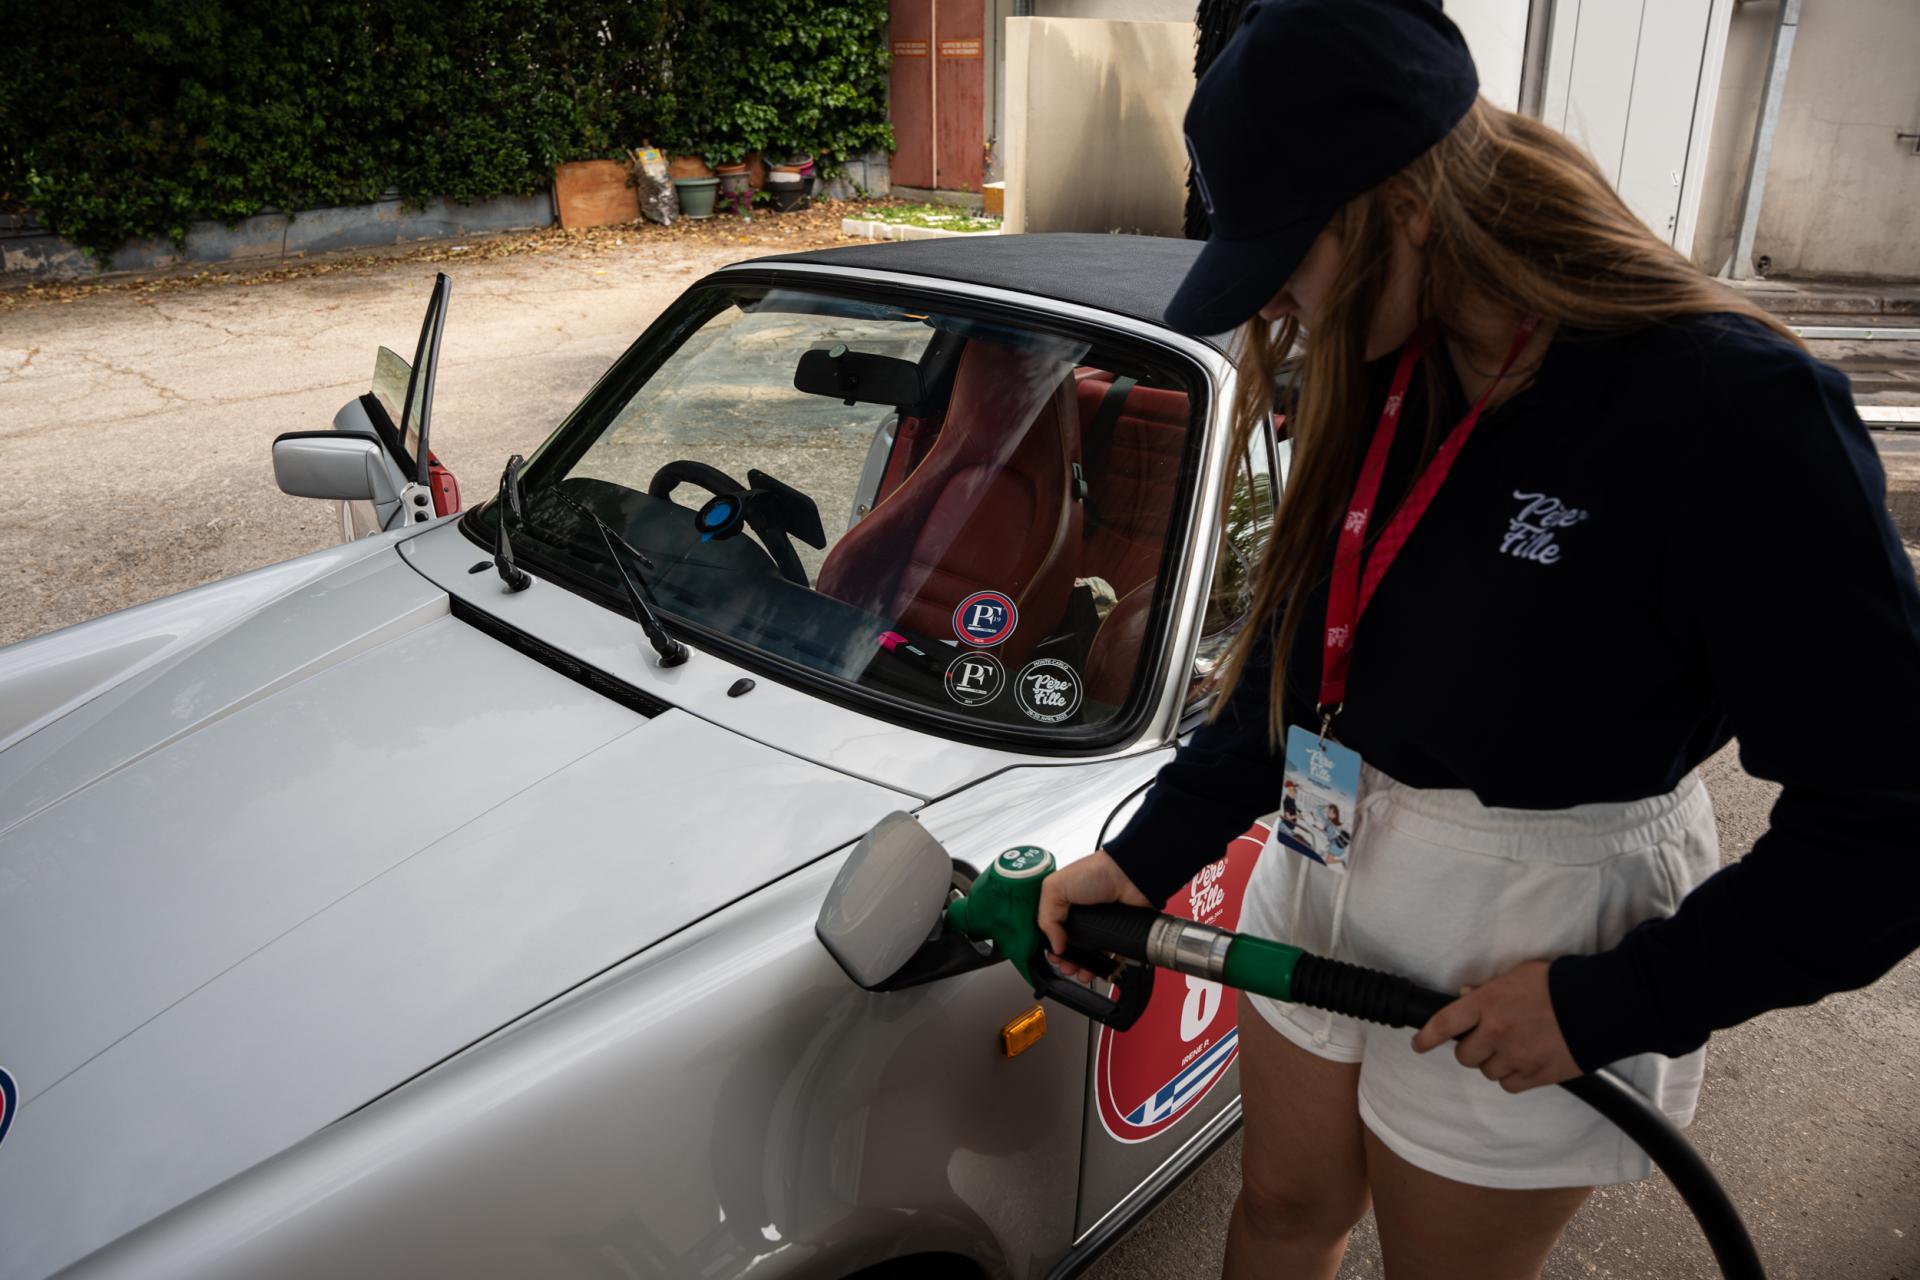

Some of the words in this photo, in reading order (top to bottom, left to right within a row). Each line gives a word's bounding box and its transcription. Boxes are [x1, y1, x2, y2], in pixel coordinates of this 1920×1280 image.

[1499, 518, 1561, 564] Fille
[1026, 674, 1069, 691] Père
[1032, 687, 1067, 707] Fille
[1188, 882, 1225, 922] Fille
